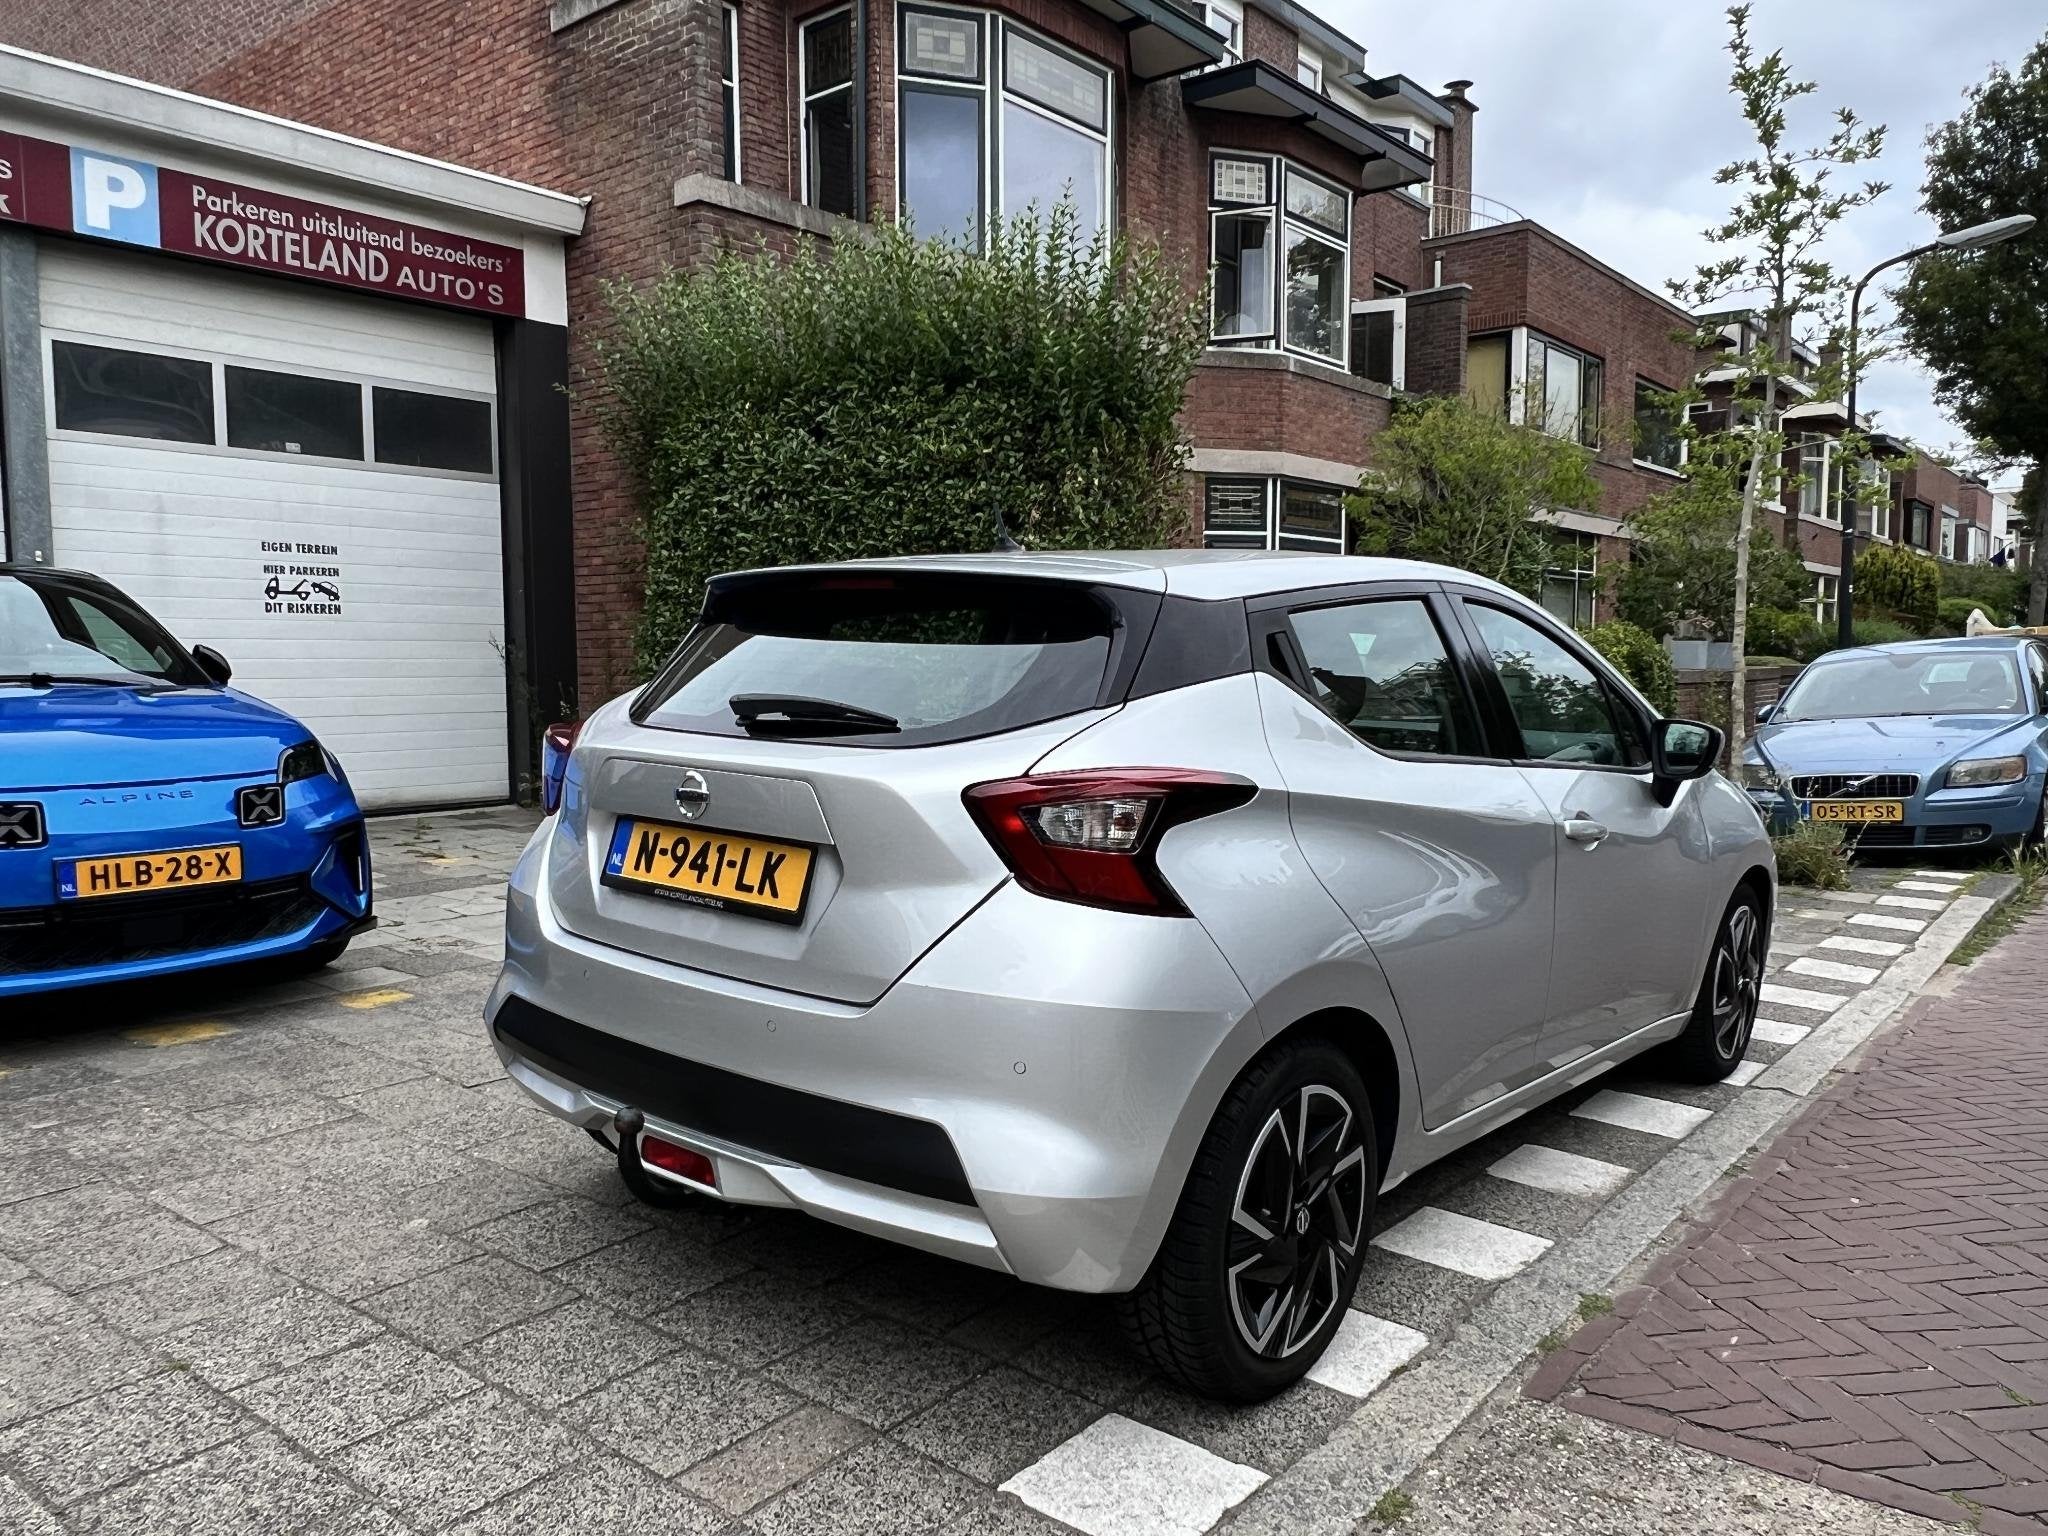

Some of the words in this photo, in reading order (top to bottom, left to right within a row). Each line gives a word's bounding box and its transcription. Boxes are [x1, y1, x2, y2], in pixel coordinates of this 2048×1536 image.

[83, 156, 147, 230] P
[192, 184, 294, 228] Parkeren
[302, 212, 404, 251] uitsluitend
[411, 231, 504, 273] bezoekers
[194, 212, 389, 283] KORTELAND
[396, 266, 504, 306] AUTO'S
[261, 541, 292, 553] EIGEN
[296, 543, 338, 555] TERREIN
[263, 564, 286, 575] HIER
[289, 566, 340, 577] PARKEREN
[264, 602, 283, 613] DIT
[287, 603, 342, 615] RISKEREN
[79, 790, 195, 806] ALPINE
[1816, 805, 1897, 819] 05-RT-SR
[611, 852, 623, 866] NL
[633, 831, 787, 899] N-941-LK
[90, 851, 232, 890] HLB-28-X
[61, 884, 77, 892] NL
